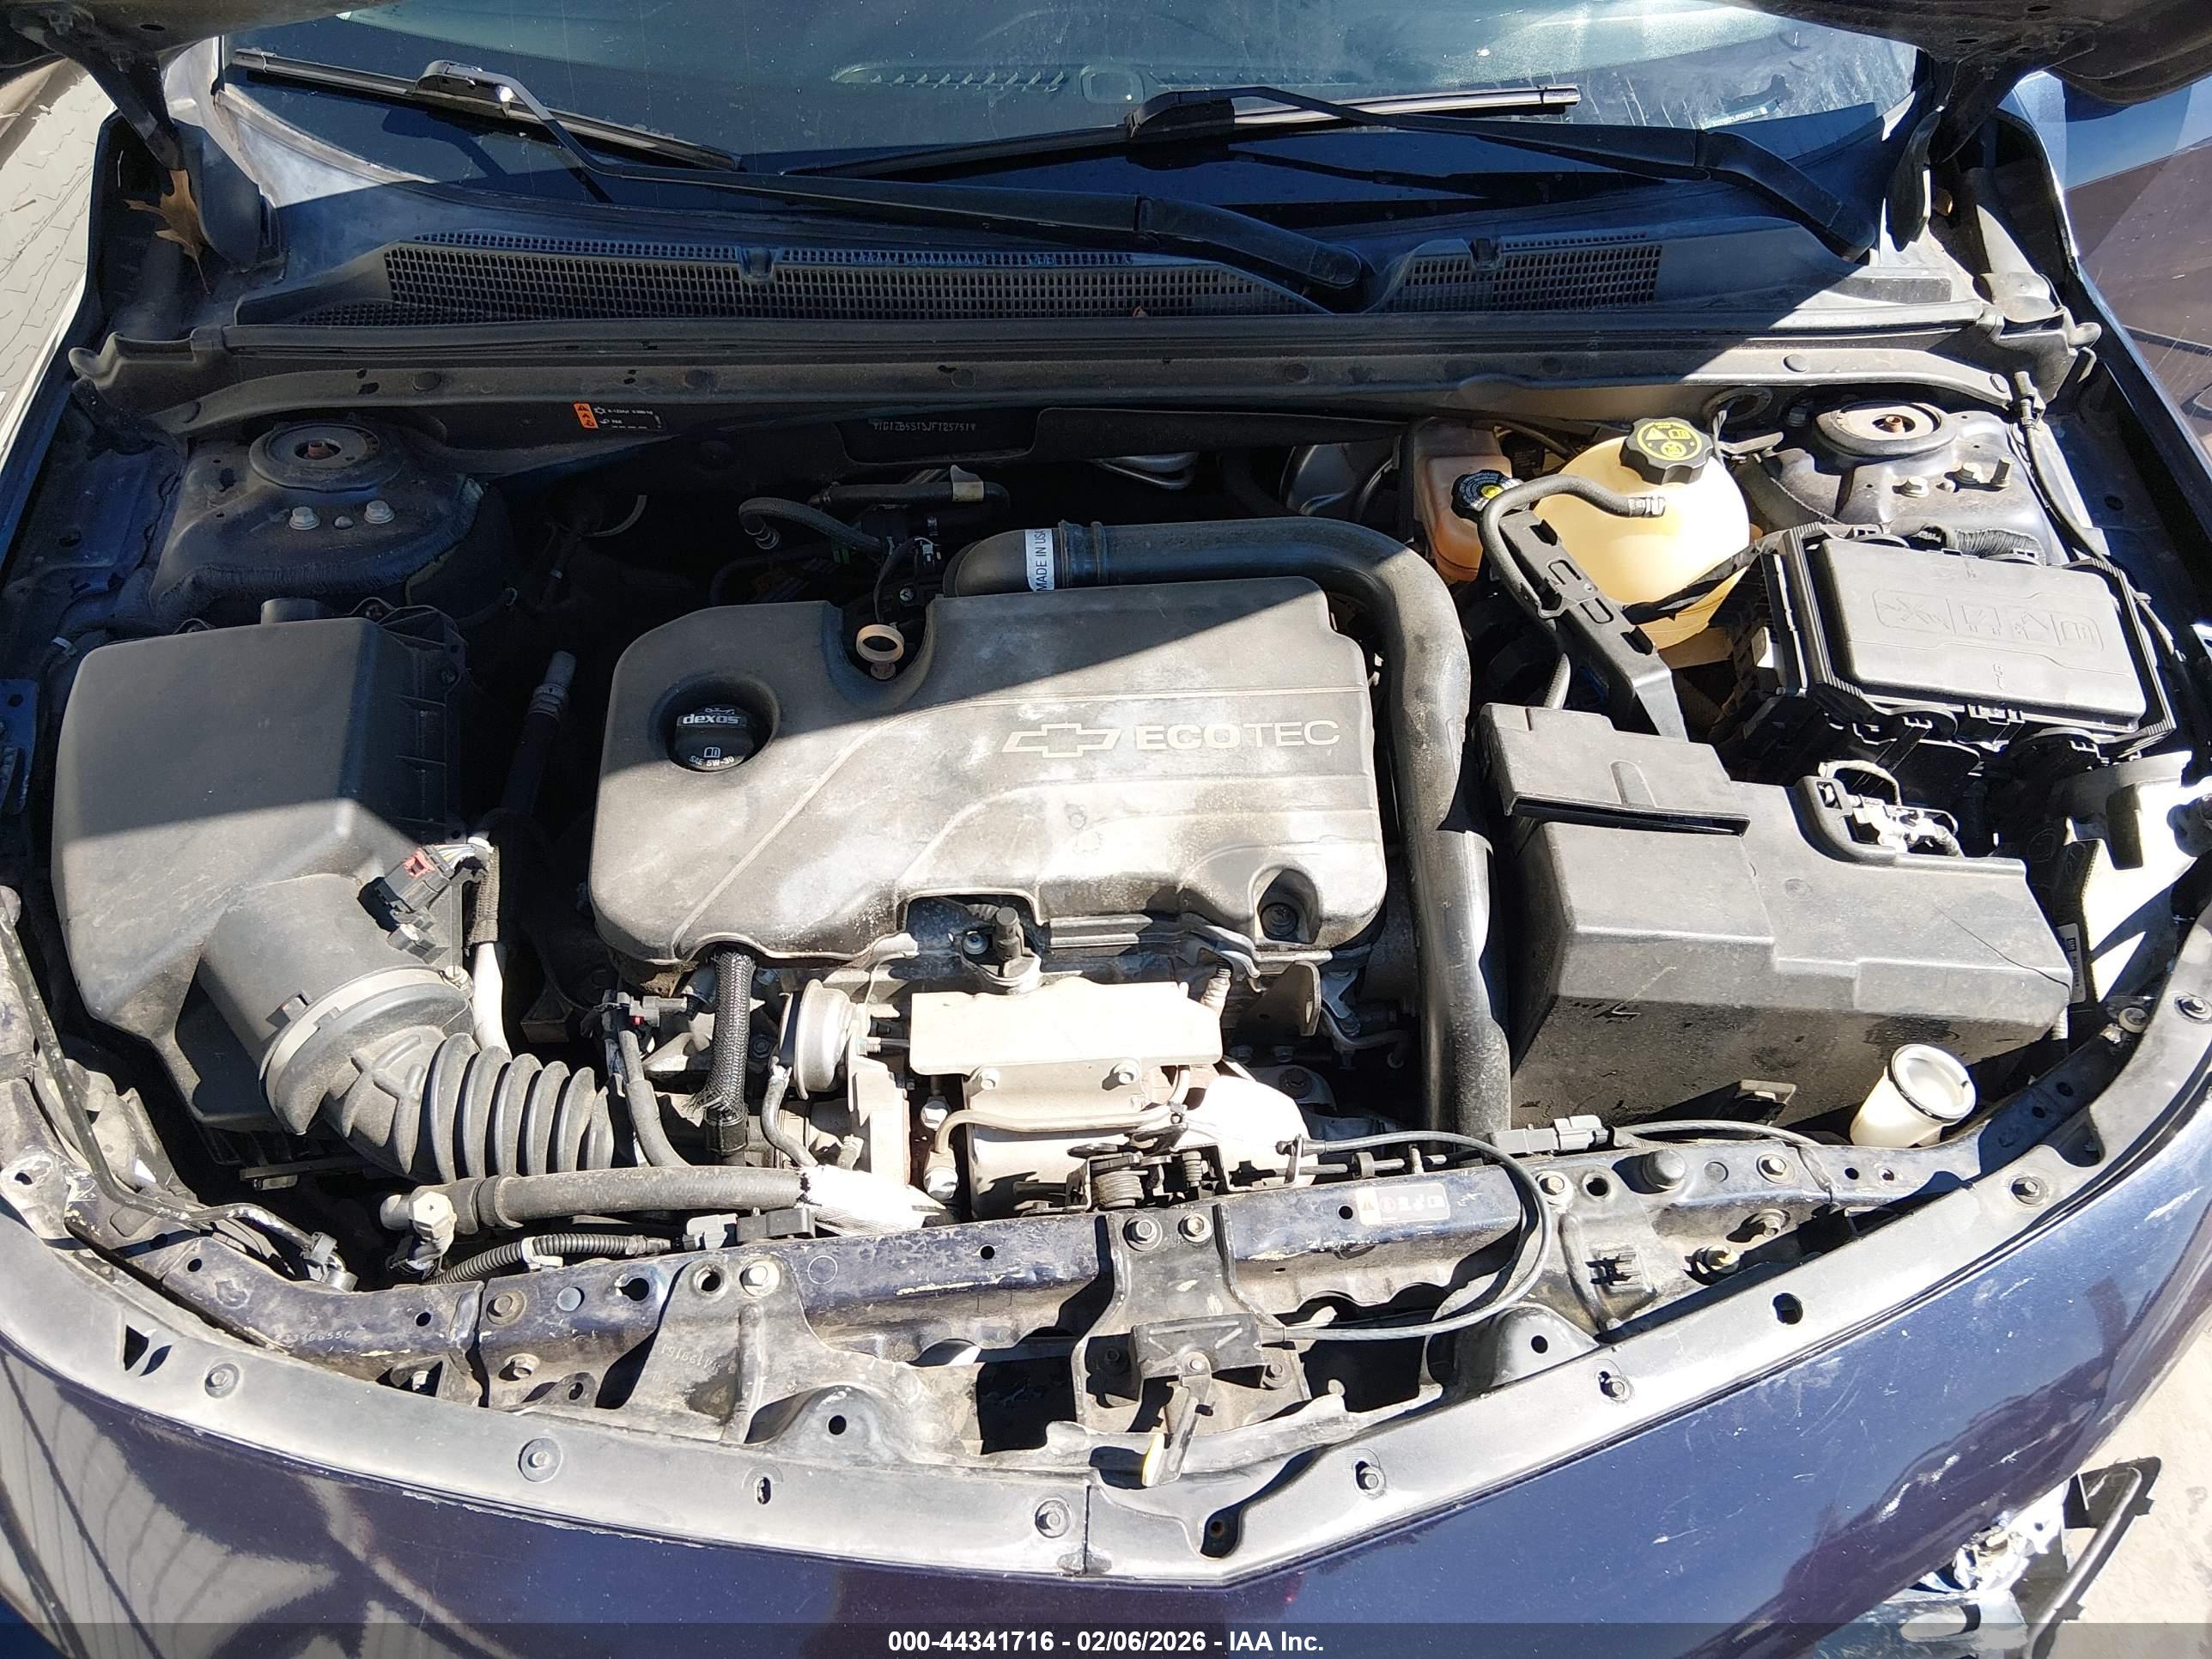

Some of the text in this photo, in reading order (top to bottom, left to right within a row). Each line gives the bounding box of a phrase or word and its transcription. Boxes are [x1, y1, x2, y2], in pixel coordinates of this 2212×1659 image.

[1034, 530, 1048, 591] MADE IN USA
[682, 713, 742, 725] dexos
[1135, 720, 1340, 750] ECOTEC
[688, 755, 735, 767] SAE 5W-30
